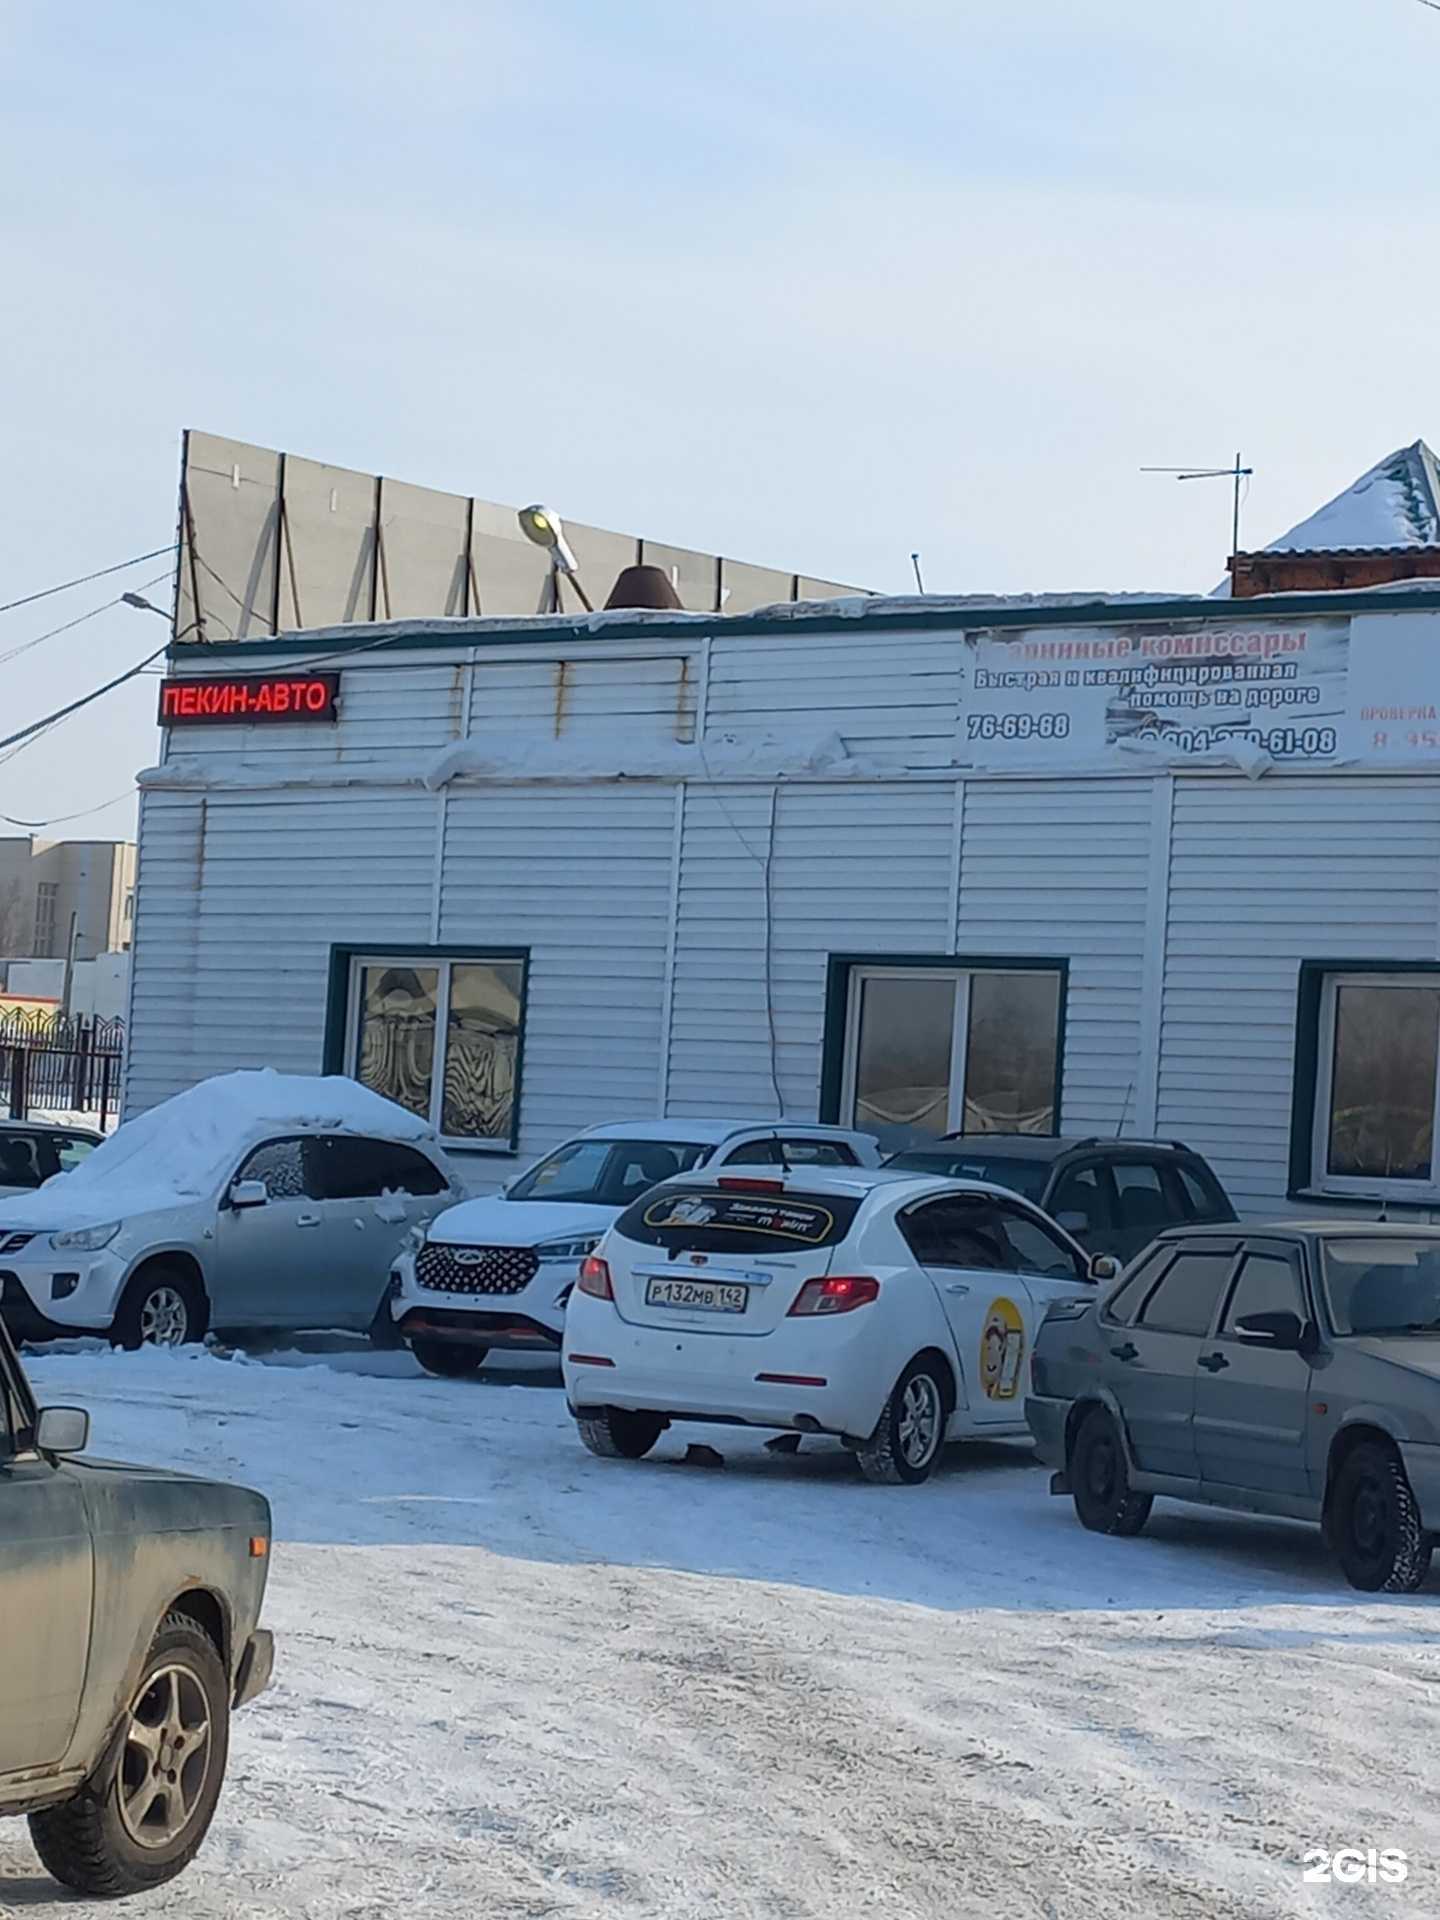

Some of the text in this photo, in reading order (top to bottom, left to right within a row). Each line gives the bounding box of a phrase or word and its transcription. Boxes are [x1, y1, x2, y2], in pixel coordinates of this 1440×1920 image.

[1140, 632, 1307, 660] комиссары
[975, 662, 1298, 691] Быстрая и квалифицированная
[163, 682, 326, 717] ПЕКИН-АВТО
[1129, 686, 1321, 709] помощь на дороге
[966, 713, 1070, 739] 76-69-68
